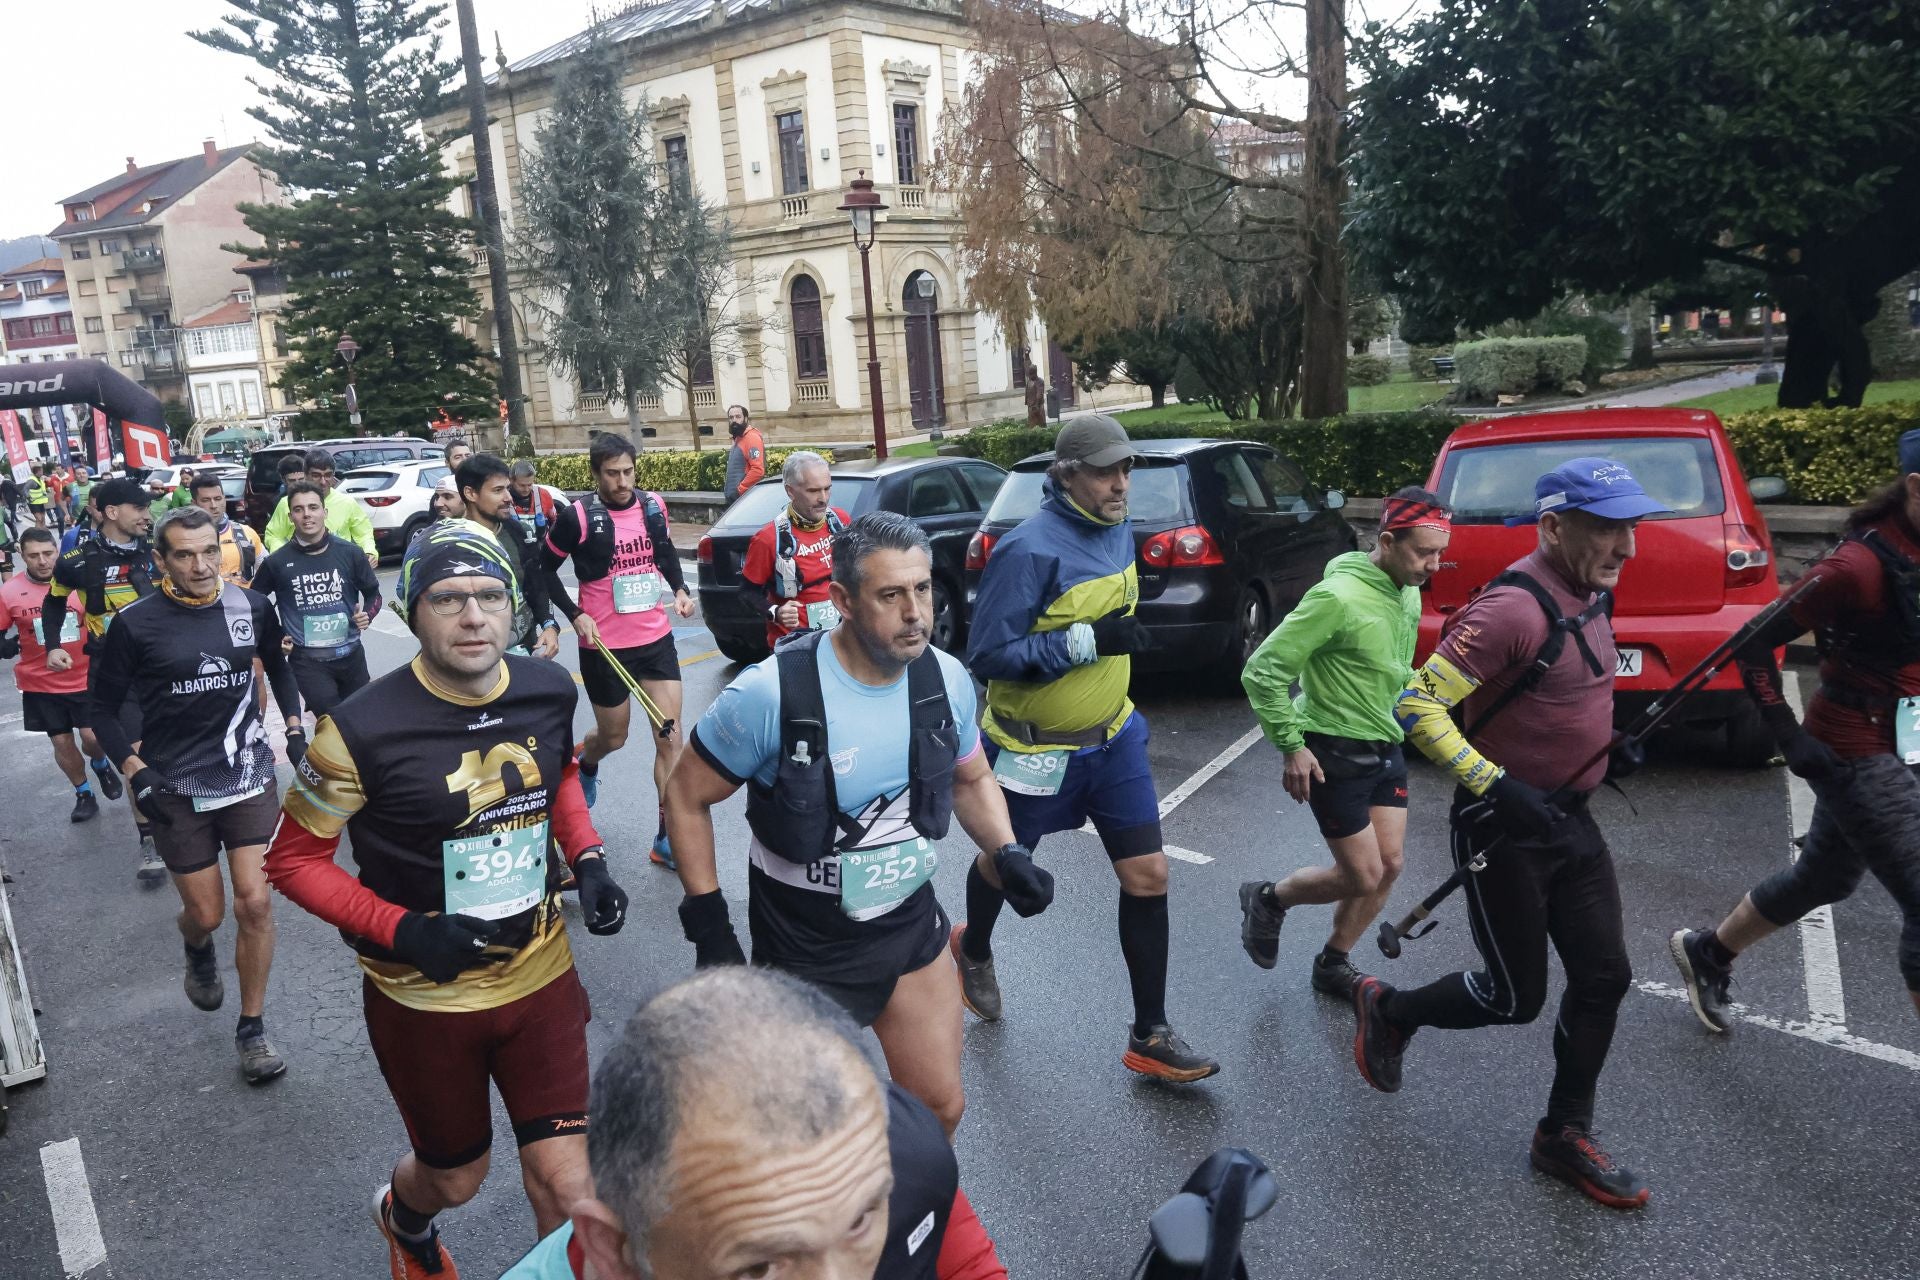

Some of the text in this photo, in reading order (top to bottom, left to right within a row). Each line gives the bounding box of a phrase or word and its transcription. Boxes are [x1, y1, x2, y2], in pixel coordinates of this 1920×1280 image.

[302, 571, 330, 585] PICU
[291, 575, 305, 607] TRAIL
[304, 583, 327, 595] LLO
[622, 581, 652, 595] 389
[307, 591, 343, 605] SORIO
[312, 620, 340, 632] 207
[171, 675, 228, 694] ALBATROS
[1014, 753, 1059, 775] 259
[478, 798, 548, 824] ANIVERSARIO
[468, 844, 535, 882] 394
[806, 861, 842, 889] CE
[864, 856, 917, 889] 252
[487, 874, 523, 888] ADOLFO
[881, 881, 900, 890] FAUS
